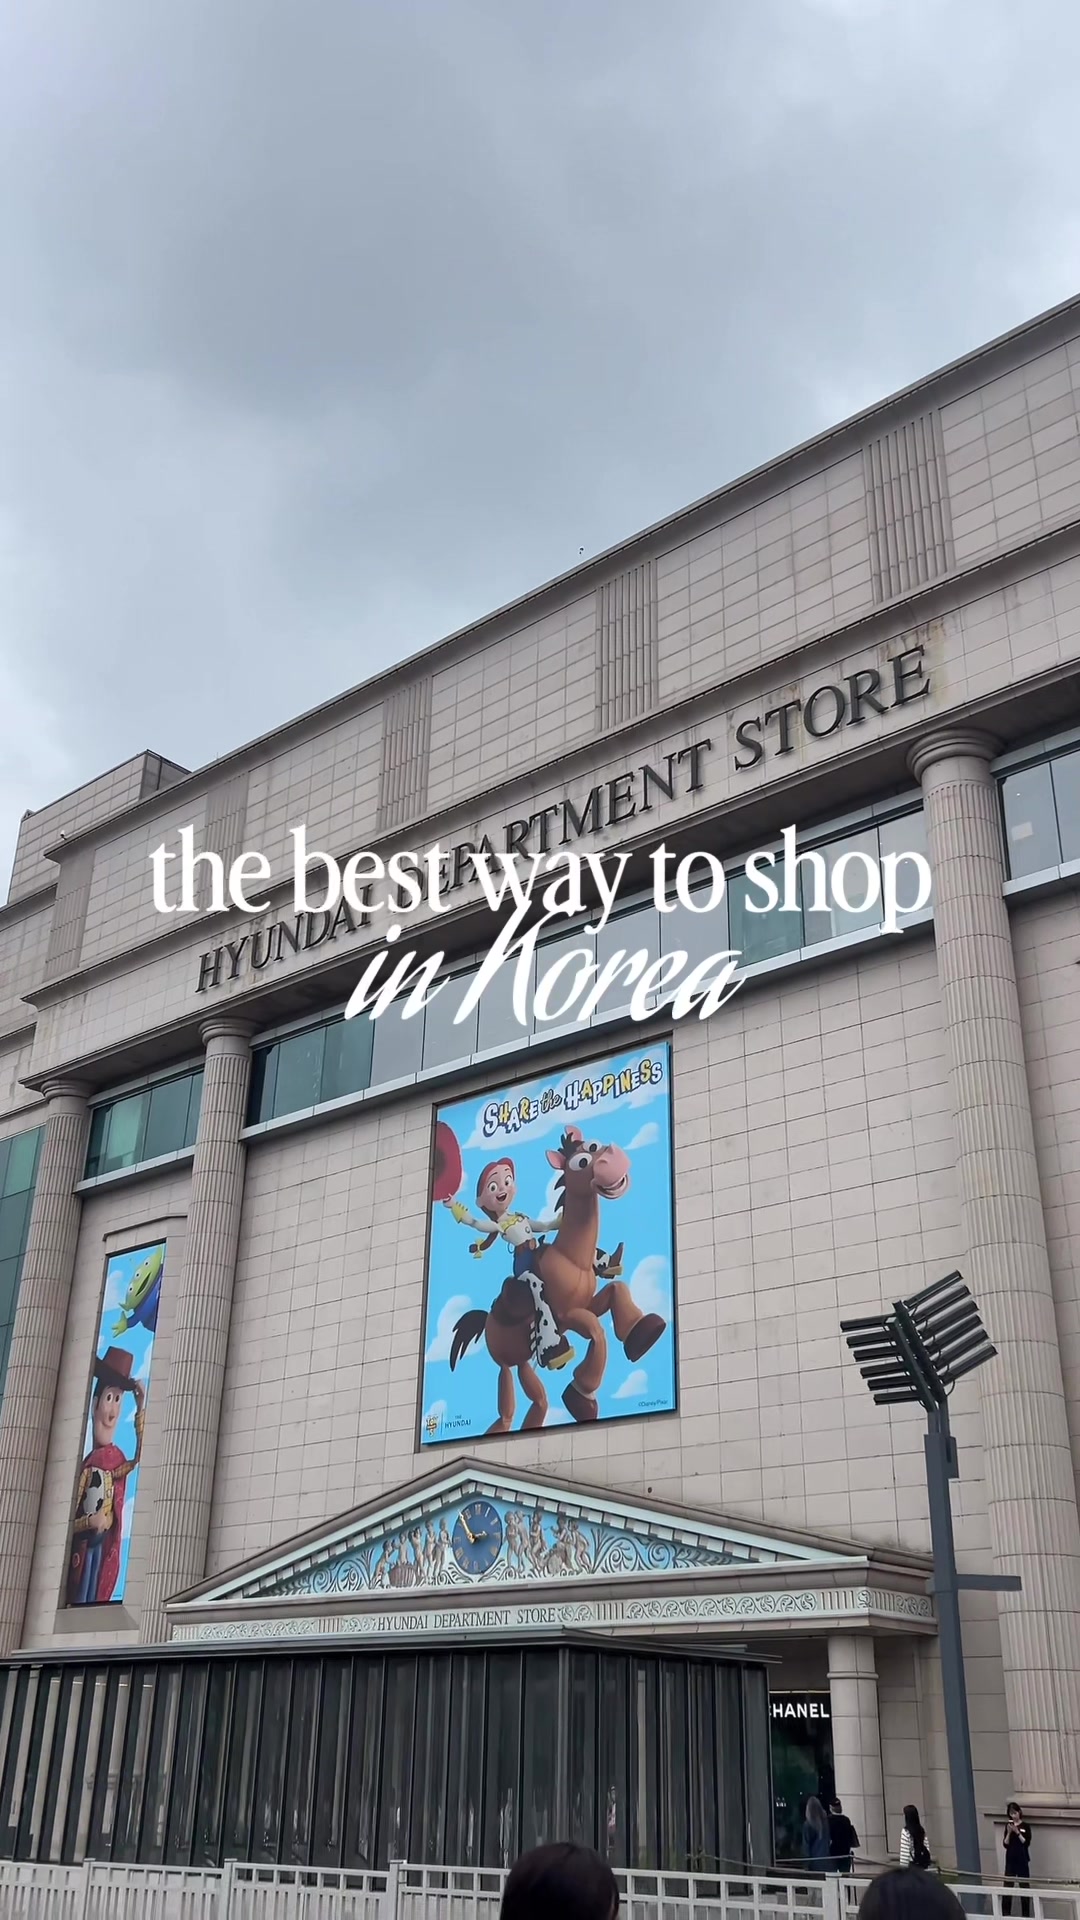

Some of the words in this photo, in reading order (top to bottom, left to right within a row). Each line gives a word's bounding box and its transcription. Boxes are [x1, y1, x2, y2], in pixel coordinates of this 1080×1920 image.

[195, 882, 373, 993] HYUNDAI
[734, 644, 931, 771] STORE
[483, 1096, 539, 1137] SHARE
[540, 1089, 562, 1114] the
[564, 1059, 663, 1111] HAPPINESS
[444, 1419, 472, 1429] HYUNDAI
[377, 1614, 429, 1631] HYUNDAI
[434, 1609, 511, 1629] DEPARTMENT
[517, 1607, 556, 1624] STORE
[769, 1702, 830, 1718] HANEL
